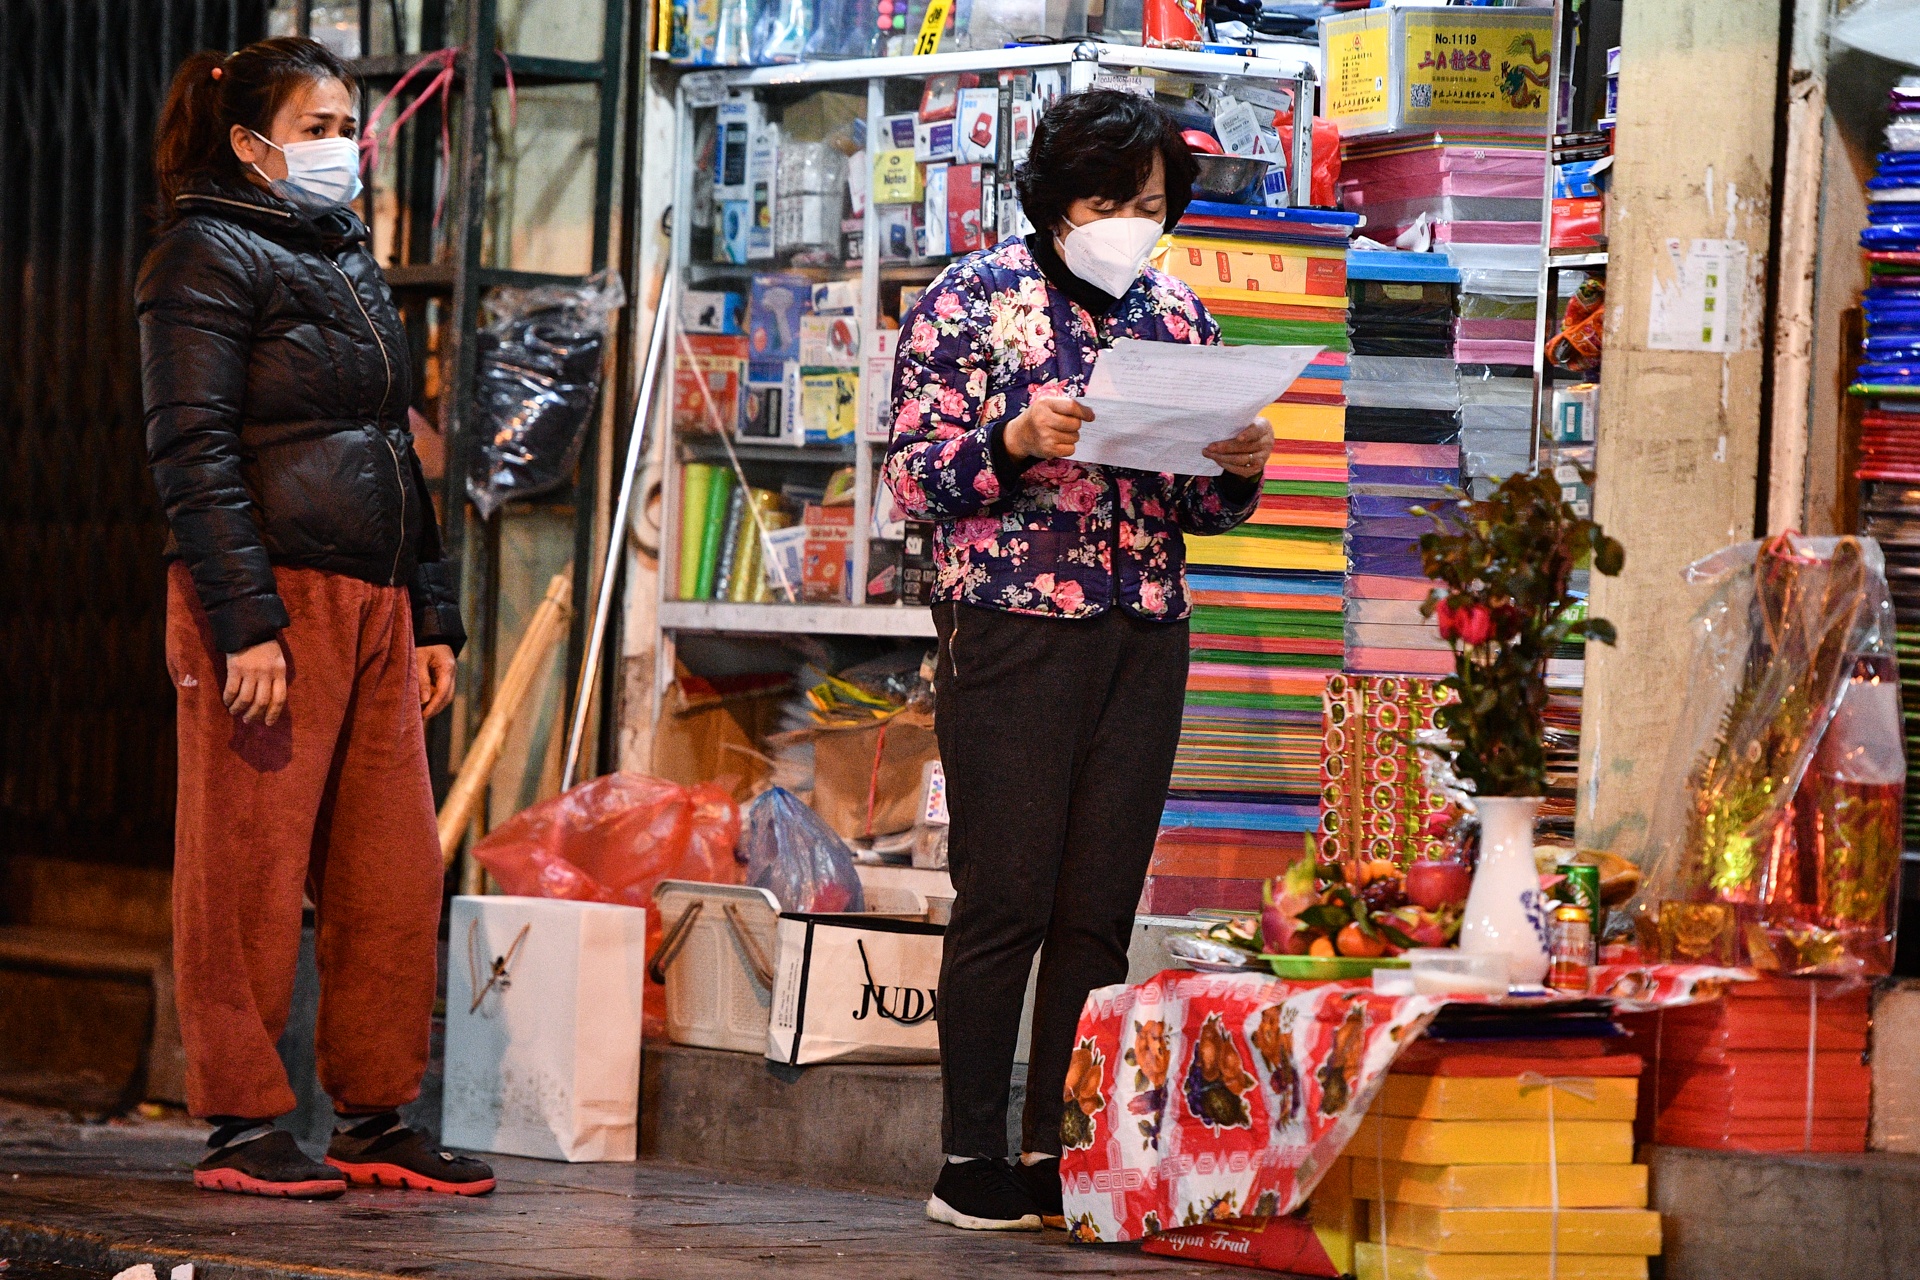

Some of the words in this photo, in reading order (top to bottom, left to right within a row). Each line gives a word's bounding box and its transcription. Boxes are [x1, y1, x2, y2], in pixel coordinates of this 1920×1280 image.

[917, 32, 937, 55] 15
[1435, 33, 1477, 44] No.1119
[883, 173, 907, 184] Notes
[1209, 1230, 1251, 1253] Fruit
